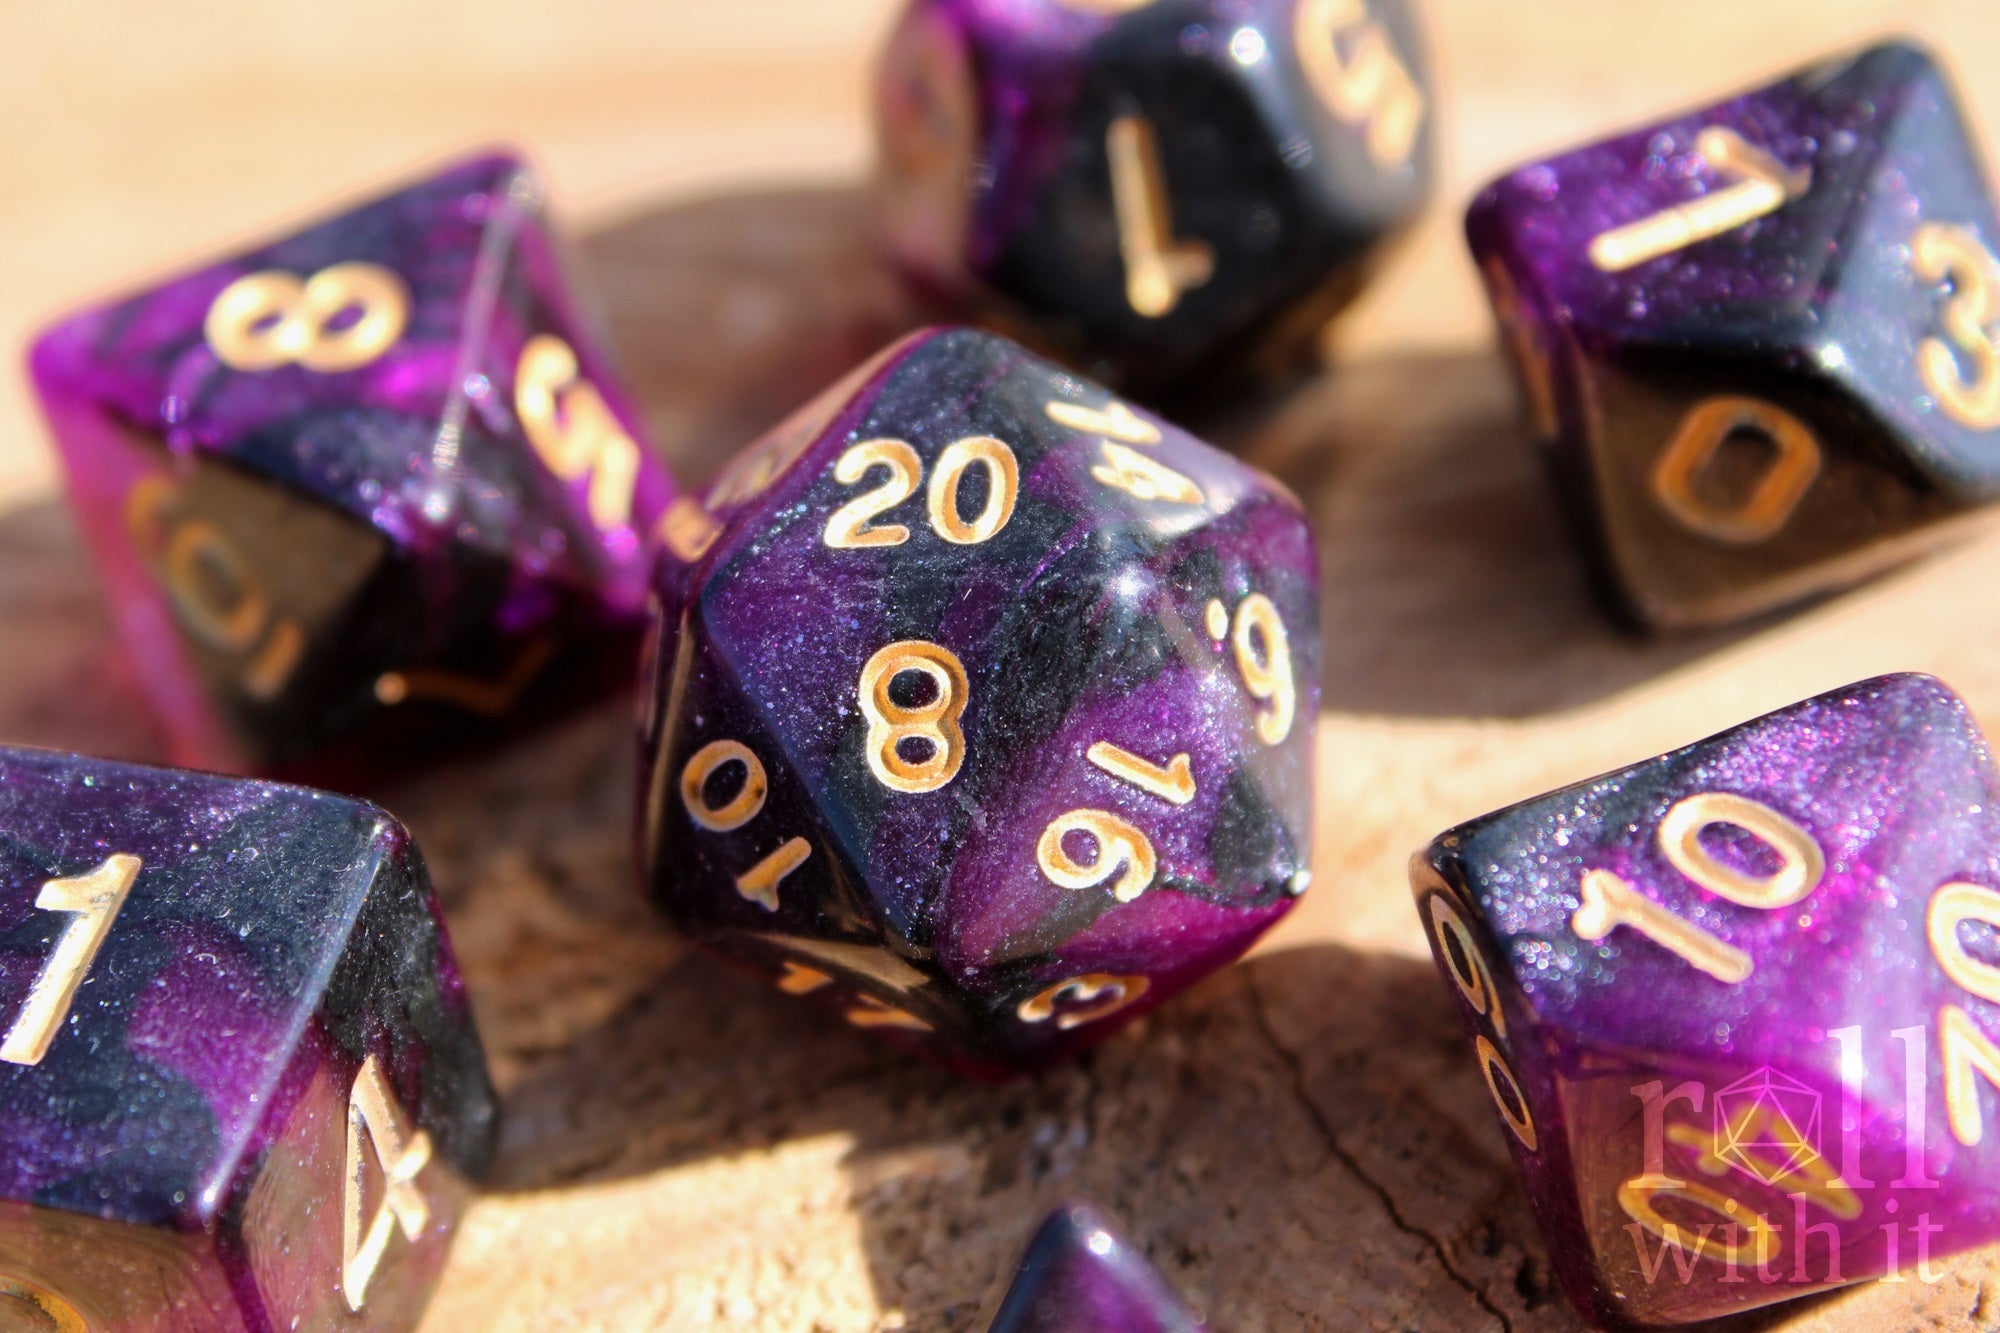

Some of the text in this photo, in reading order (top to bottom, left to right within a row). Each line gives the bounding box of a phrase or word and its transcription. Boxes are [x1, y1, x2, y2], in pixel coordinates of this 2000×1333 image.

[203, 262, 408, 372] 8
[1910, 221, 2000, 432] 3
[822, 436, 1020, 549] 20
[1045, 400, 1206, 506] 14
[857, 640, 970, 794] 8
[680, 738, 812, 912] 10
[1572, 791, 1826, 984] 10
[0, 852, 142, 1066] 1
[342, 1054, 432, 1312] 4
